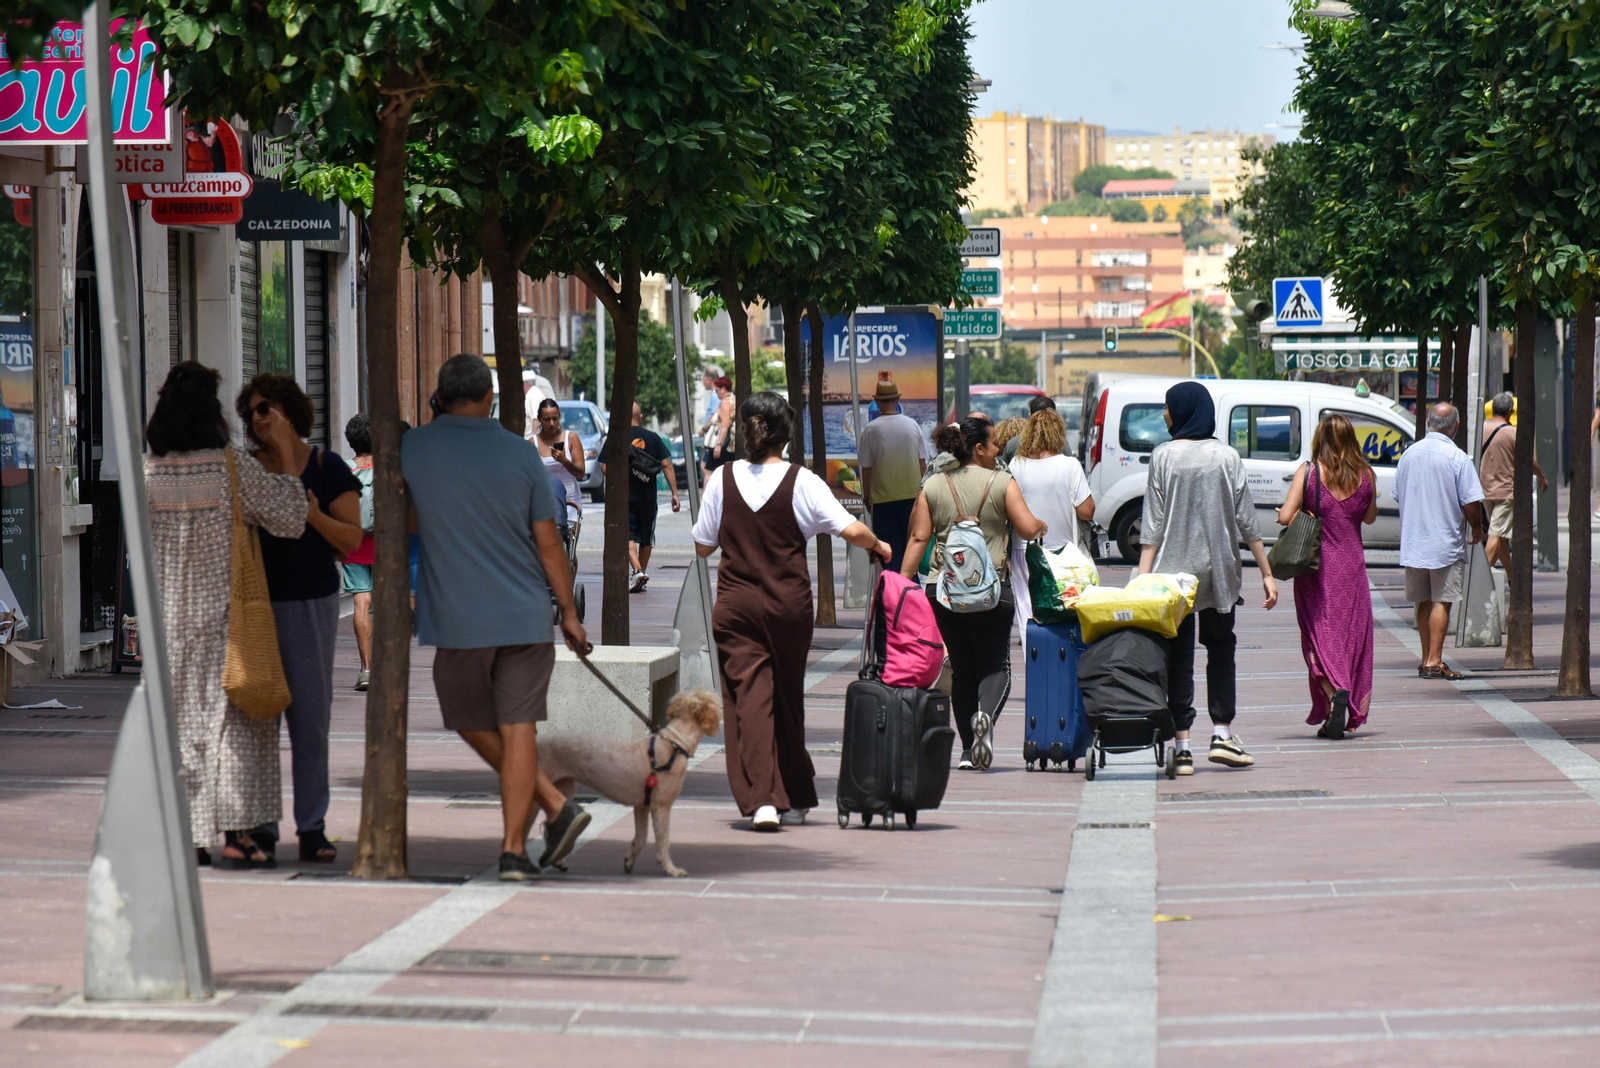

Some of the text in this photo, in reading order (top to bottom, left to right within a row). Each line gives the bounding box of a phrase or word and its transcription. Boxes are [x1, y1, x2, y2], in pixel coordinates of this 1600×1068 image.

[151, 179, 242, 195] Cruzcampo
[157, 202, 234, 214] LA PERSEVERANCIA
[248, 219, 331, 230] CALZEDONIA
[961, 273, 994, 282] Tolosa
[944, 313, 993, 322] barrio de
[958, 322, 994, 334] Isidro
[834, 334, 907, 363] LARIOS
[1359, 353, 1380, 368] LA
[1384, 353, 1441, 368] GATTA
